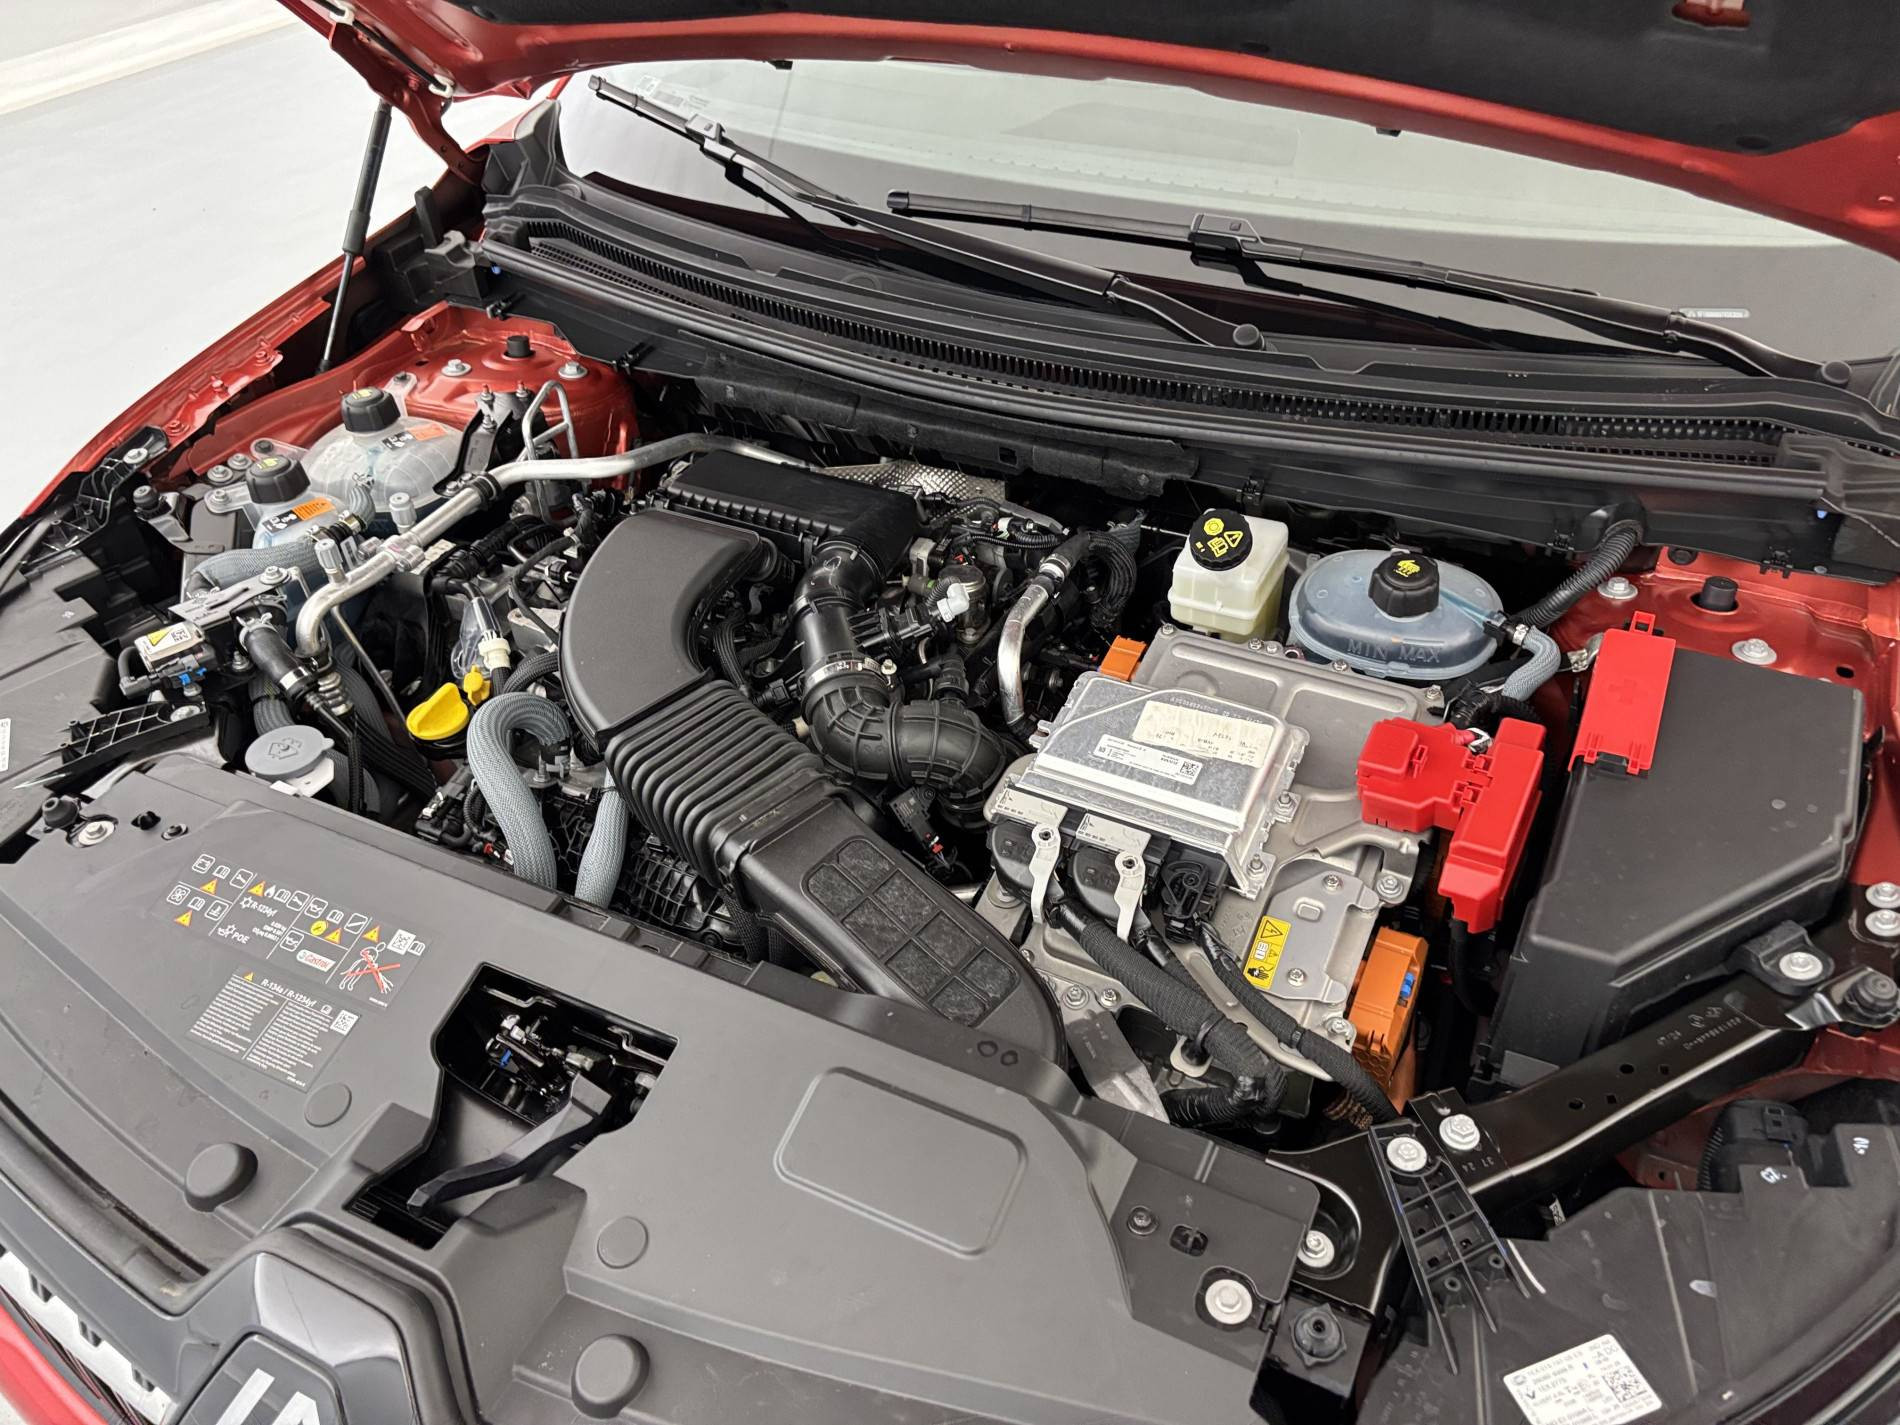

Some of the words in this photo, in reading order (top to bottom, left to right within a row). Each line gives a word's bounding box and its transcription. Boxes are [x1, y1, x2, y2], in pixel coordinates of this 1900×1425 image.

[1347, 638, 1389, 660] MIN
[1398, 645, 1441, 664] MAX
[231, 931, 250, 944] POE
[304, 952, 330, 969] Castrol
[260, 978, 283, 994] R-134a
[287, 990, 317, 1008] R-1234yf
